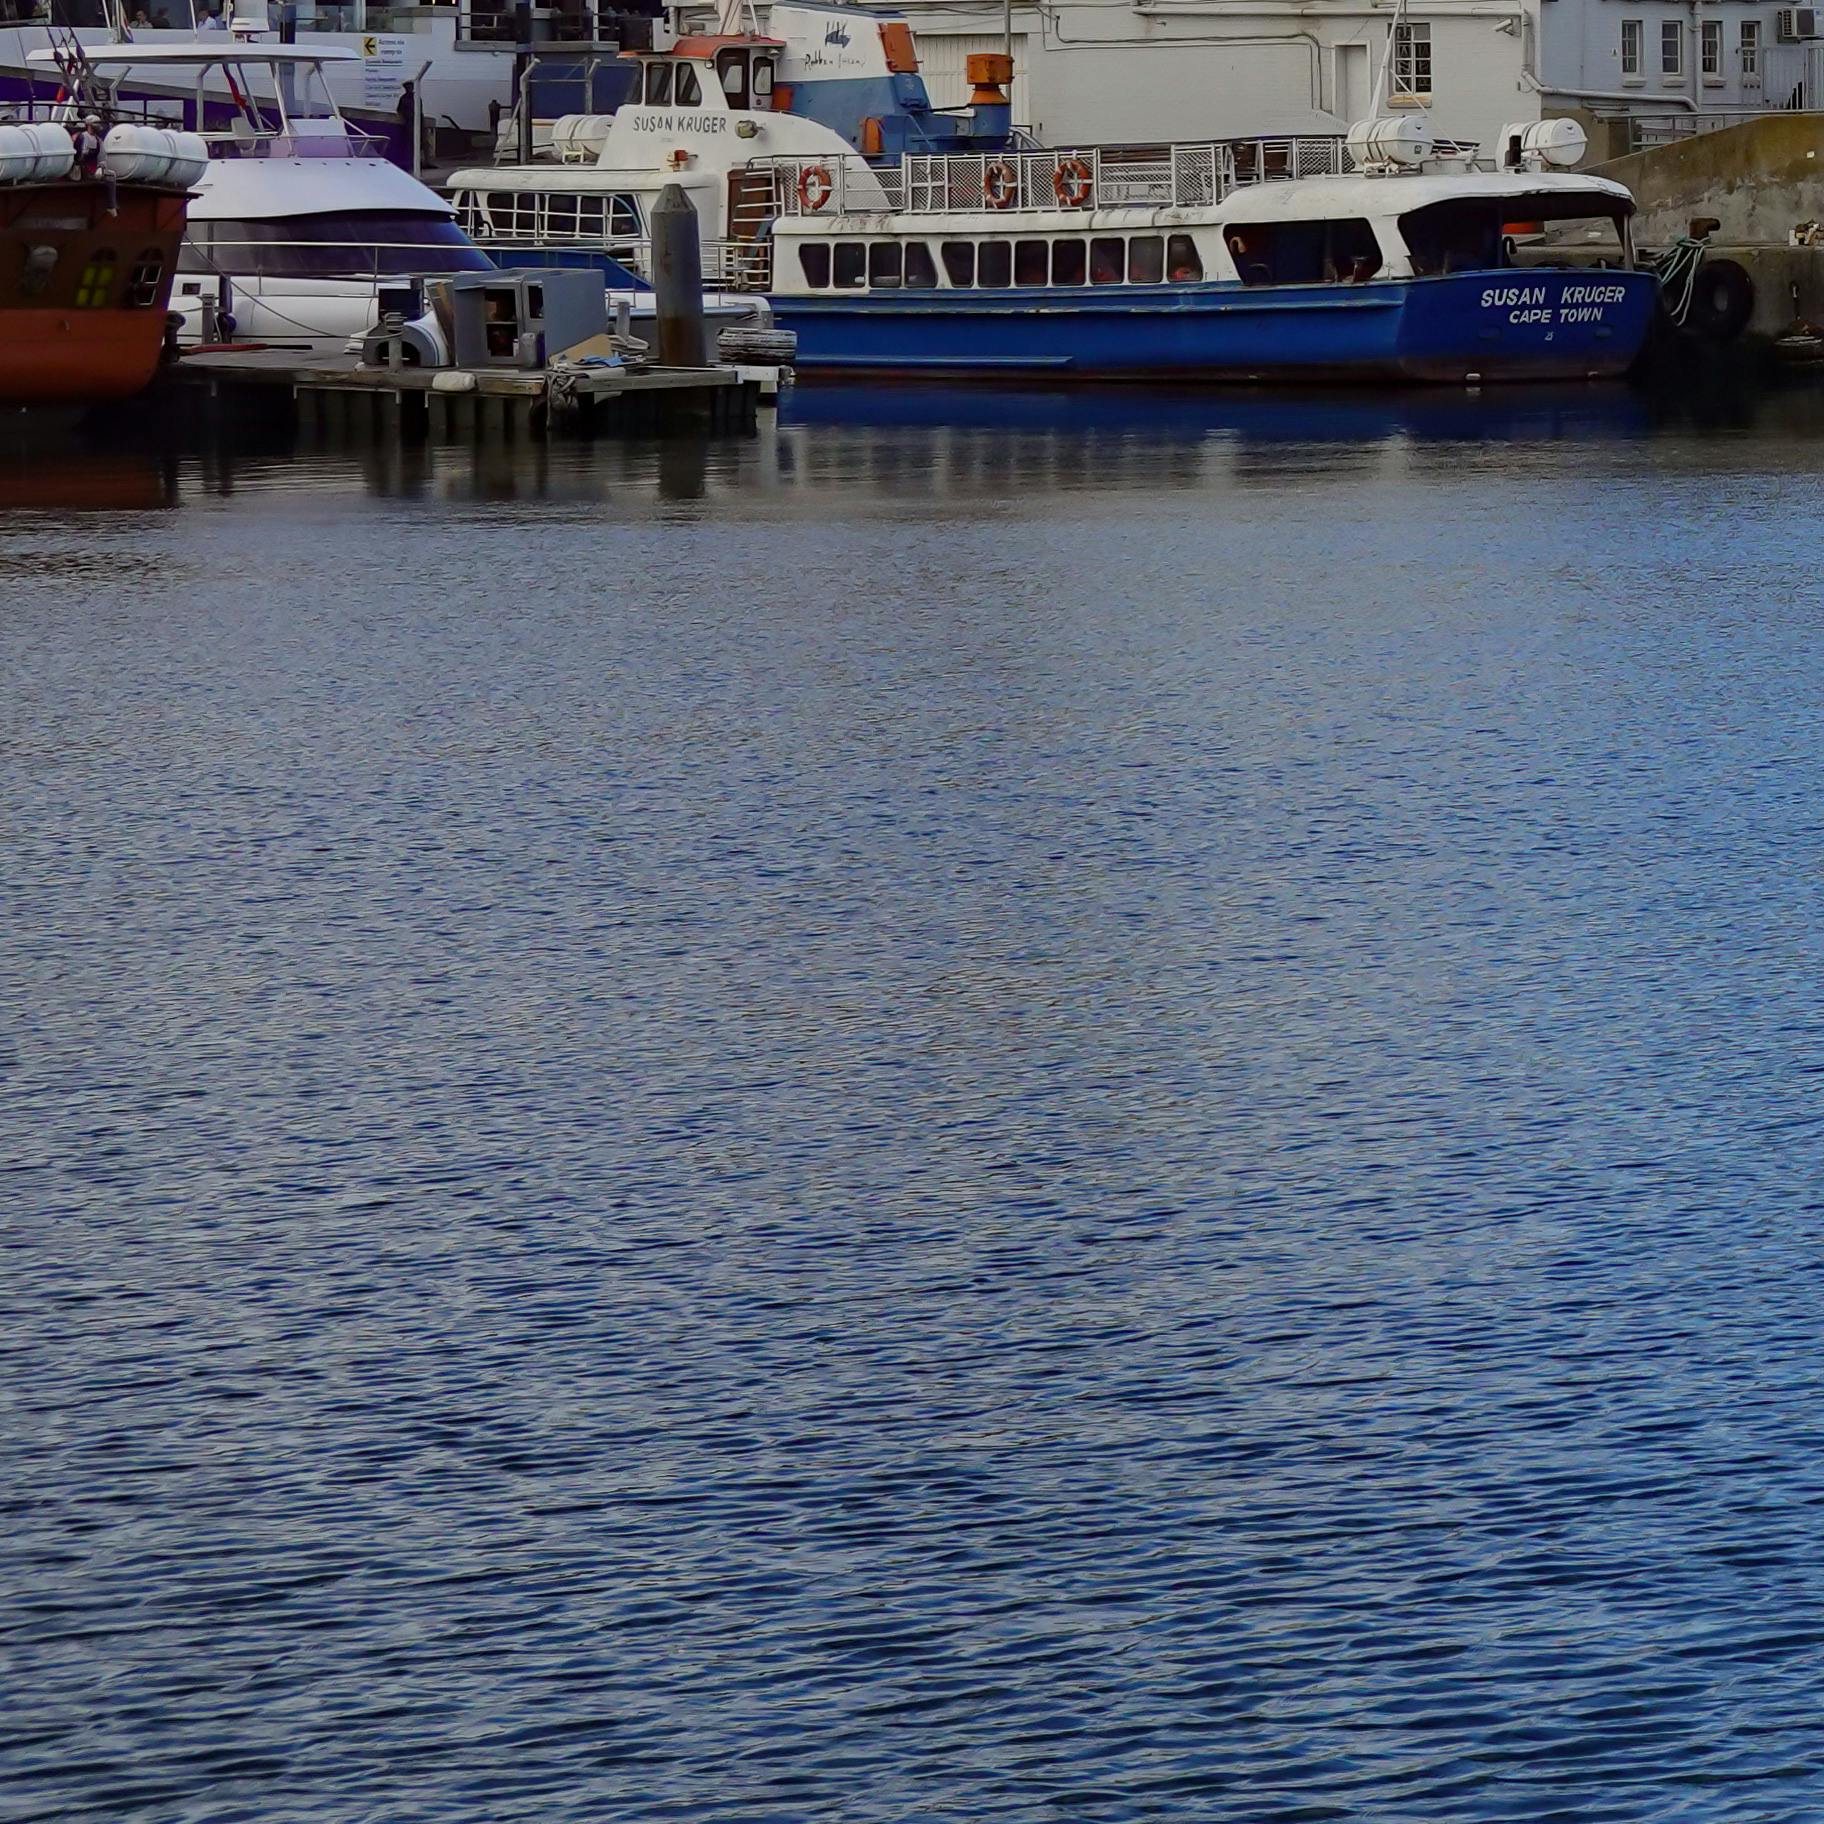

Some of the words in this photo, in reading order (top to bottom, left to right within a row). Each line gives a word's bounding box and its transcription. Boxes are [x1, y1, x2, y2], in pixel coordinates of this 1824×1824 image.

[633, 116, 673, 133] SUSAN
[677, 116, 727, 133] KRUGER
[1481, 286, 1546, 307] SUSAN
[1561, 286, 1626, 304] KRUGER
[1509, 309, 1552, 324] CAPE
[1559, 308, 1603, 323] TOWN
